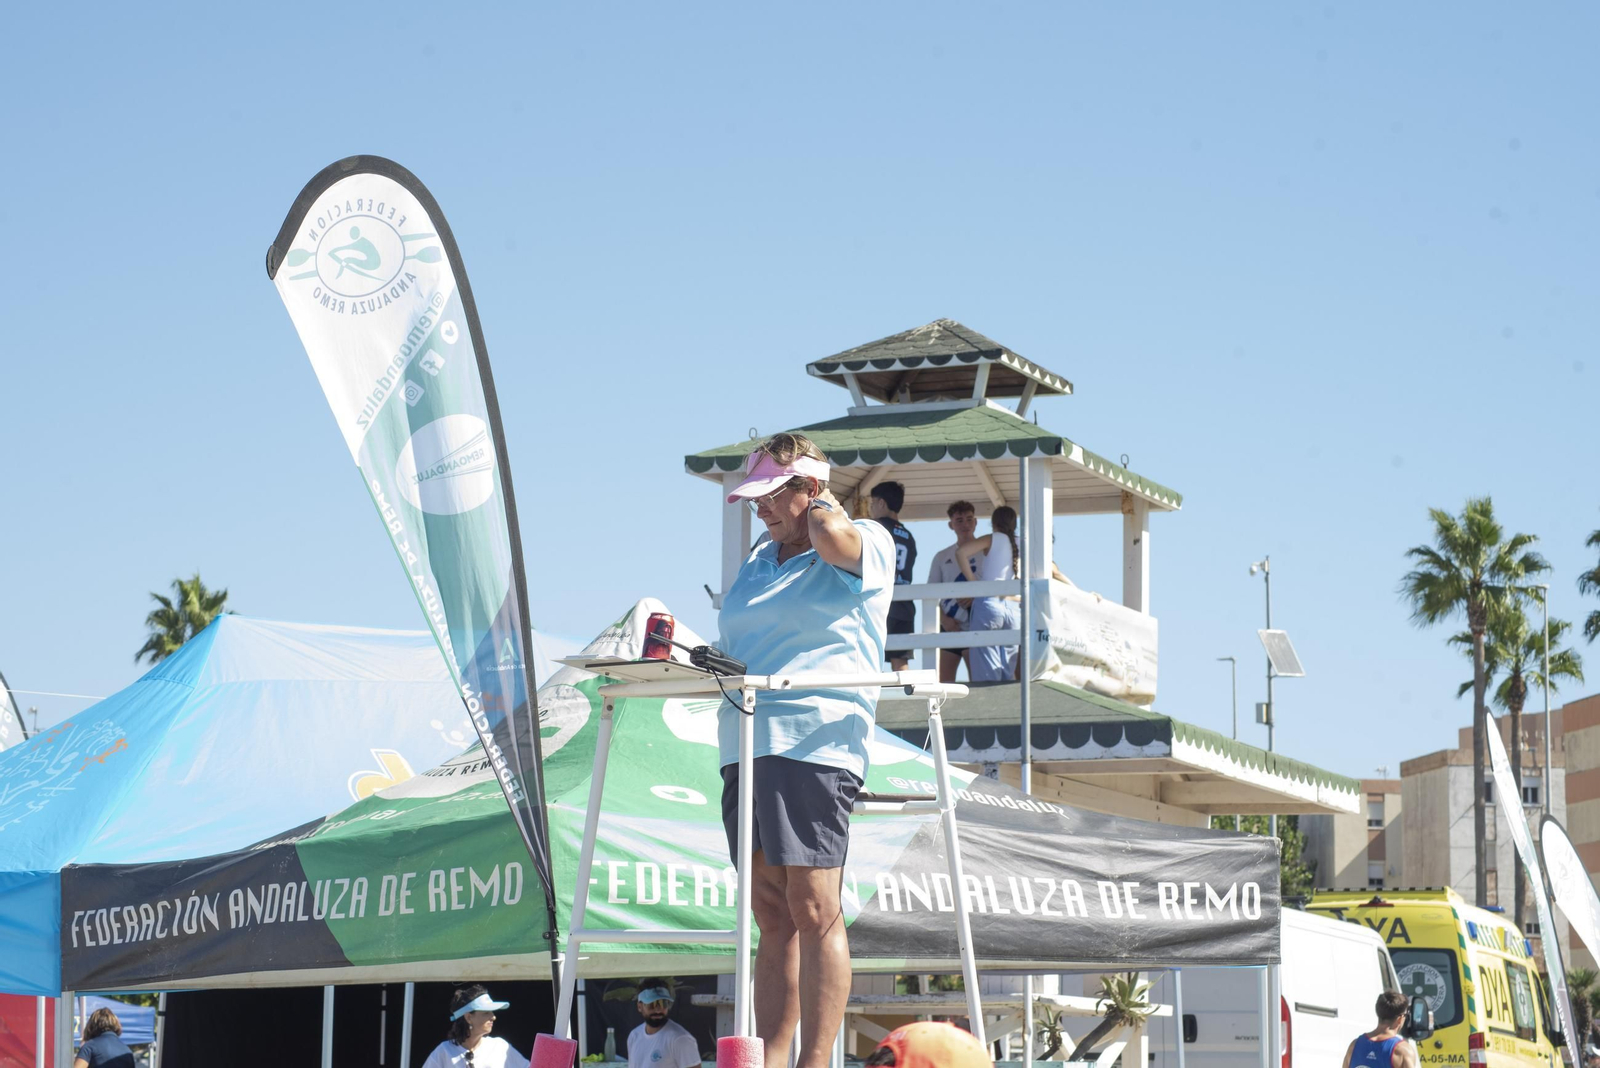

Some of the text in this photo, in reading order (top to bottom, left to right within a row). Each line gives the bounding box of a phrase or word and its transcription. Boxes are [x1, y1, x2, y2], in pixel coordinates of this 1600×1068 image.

[461, 760, 494, 775] REM
[71, 861, 523, 948] FEDERACIÓN ANDALUZA DE REMO
[875, 872, 1088, 918] ANDALUZA
[1098, 881, 1142, 919] DE
[1158, 881, 1262, 920] REMO
[1346, 917, 1412, 943] YA
[1479, 965, 1511, 1024] DYA
